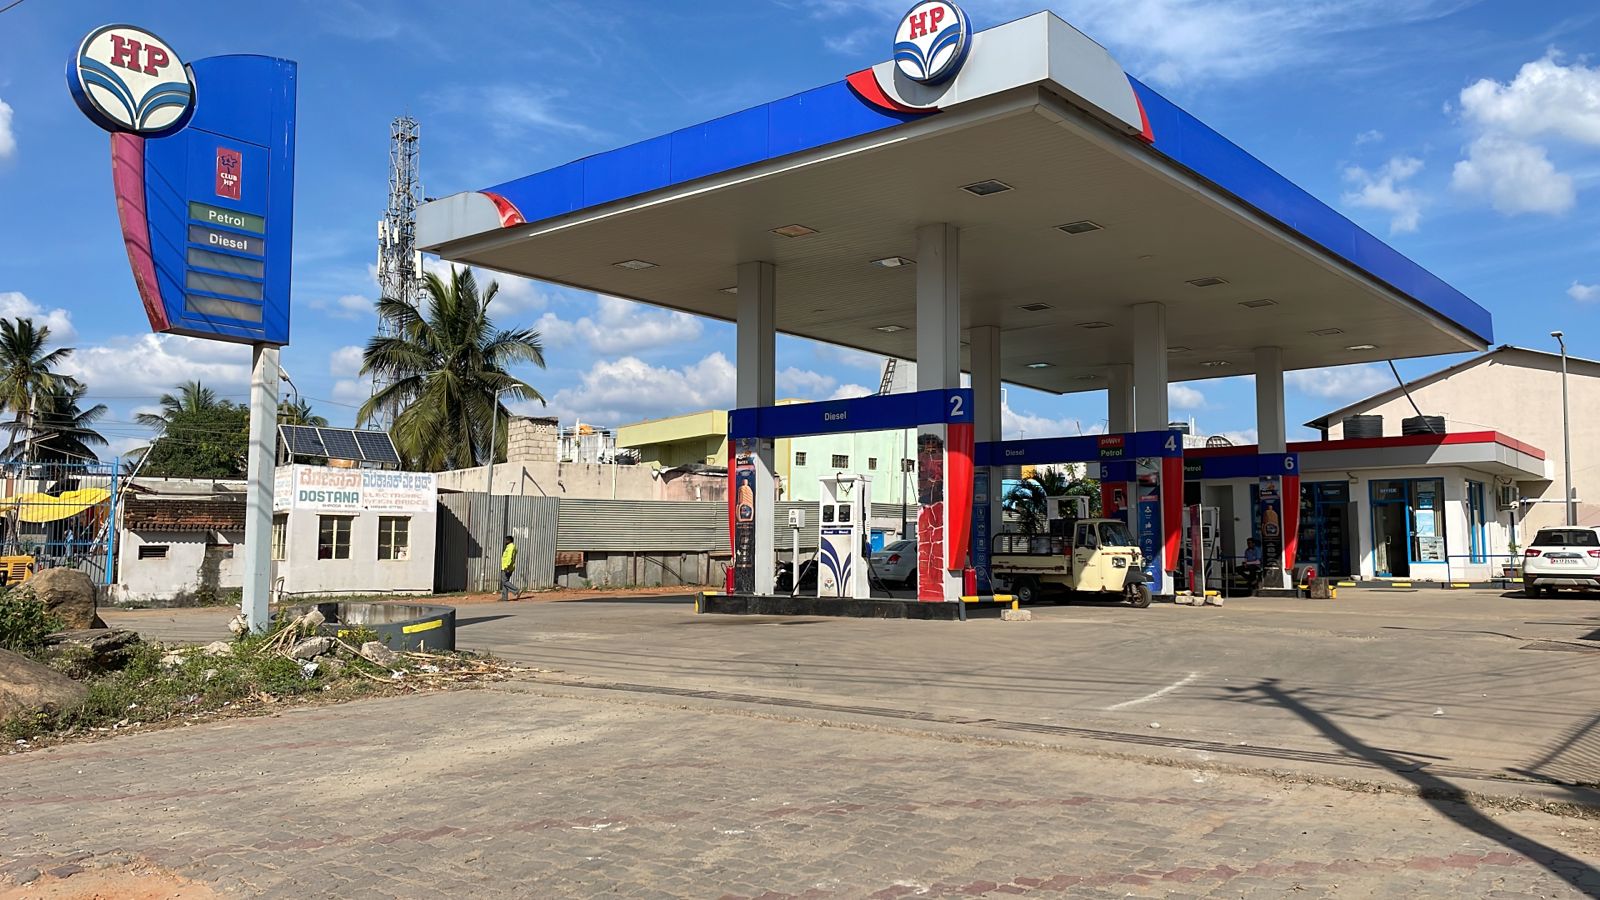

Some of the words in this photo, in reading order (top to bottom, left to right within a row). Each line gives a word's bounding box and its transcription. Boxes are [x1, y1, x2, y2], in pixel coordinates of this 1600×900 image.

[909, 6, 945, 40] HP
[110, 34, 170, 77] HP
[220, 172, 238, 181] CLUB
[223, 179, 234, 187] HP
[208, 210, 245, 227] Petrol
[209, 233, 248, 250] Diesel
[949, 395, 964, 417] 2
[824, 411, 847, 421] Diesel
[728, 415, 733, 433] 1
[1164, 435, 1177, 451] 4
[1100, 449, 1123, 457] Petrol
[1284, 456, 1295, 470] 6
[1101, 466, 1109, 478] 5
[299, 490, 360, 504] DOSTANA
